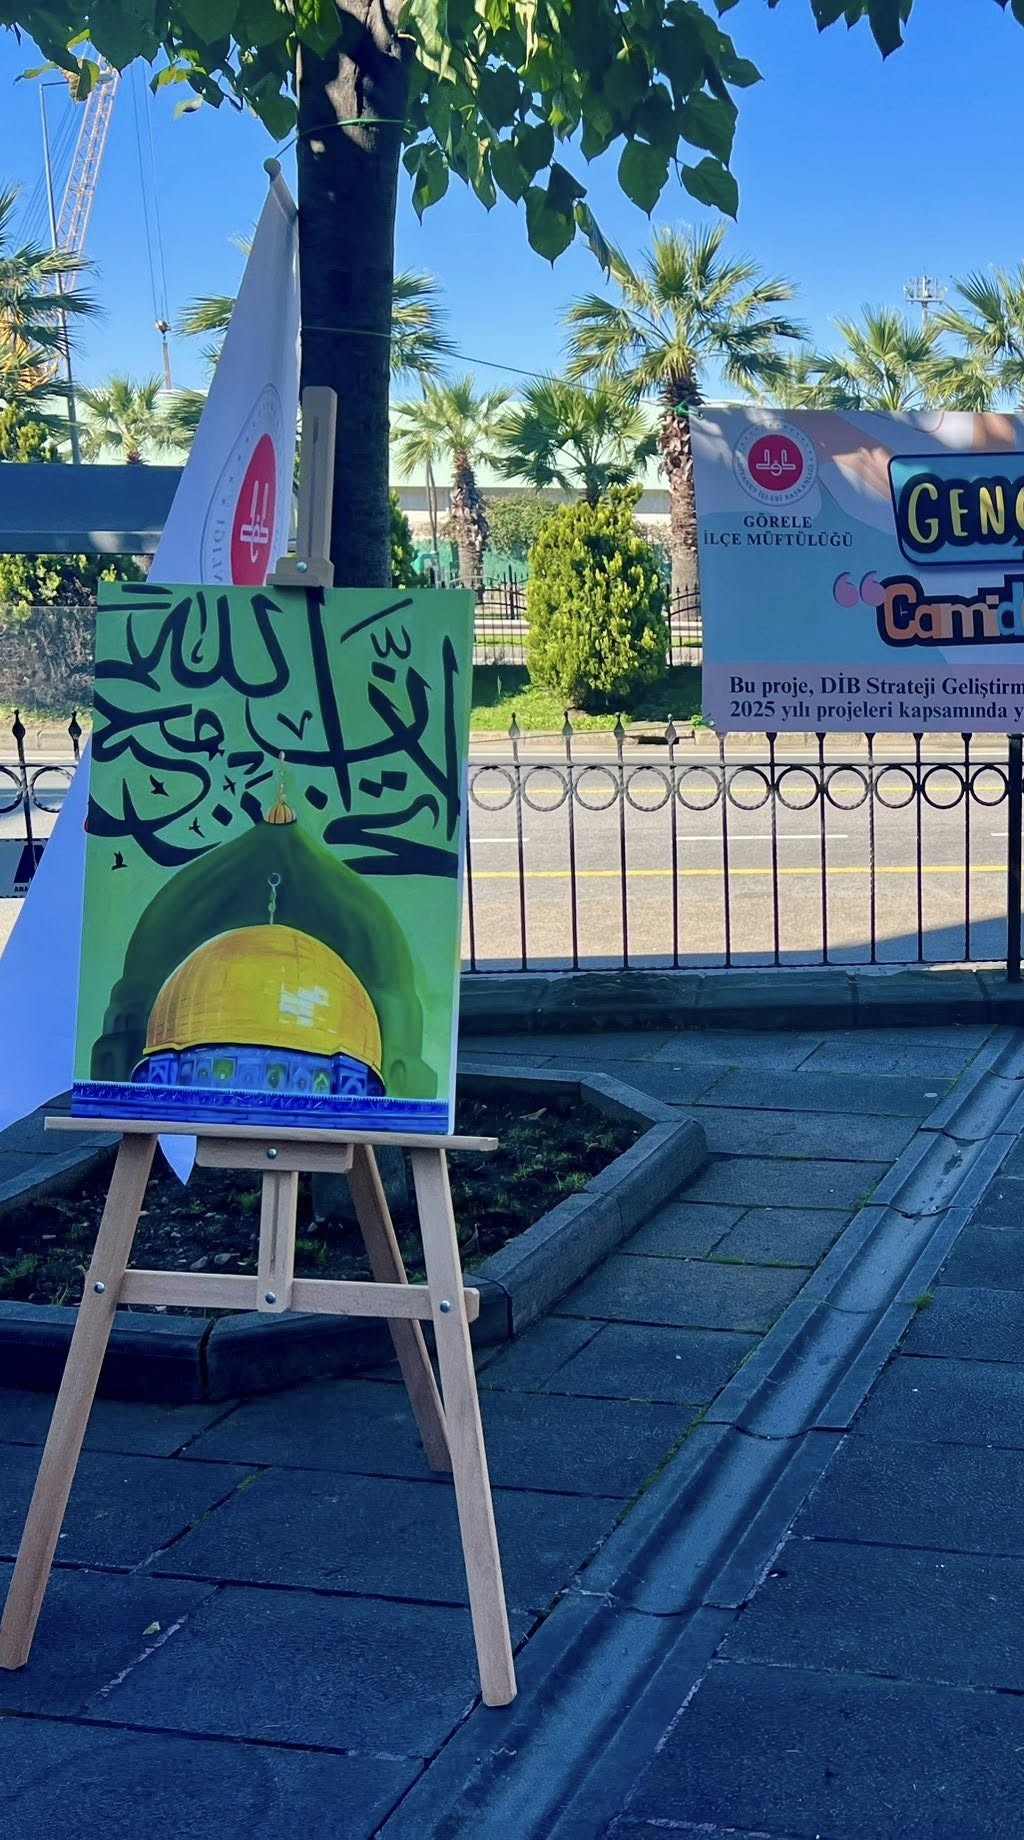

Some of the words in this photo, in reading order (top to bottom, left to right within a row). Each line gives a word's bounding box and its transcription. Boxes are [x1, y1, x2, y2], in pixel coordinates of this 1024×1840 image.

[743, 513, 812, 528] GÖRELE
[703, 530, 742, 547] İLÇE
[747, 530, 853, 548] MÜFTÜLÜĞÜ
[729, 676, 756, 694] Bu
[762, 676, 814, 699] proje,
[820, 672, 861, 694] DİB
[866, 676, 936, 699] Strateji
[729, 700, 776, 718] 2025
[782, 700, 810, 721] yılı
[817, 700, 893, 722] projeleri
[899, 700, 1007, 722] kapsamında
